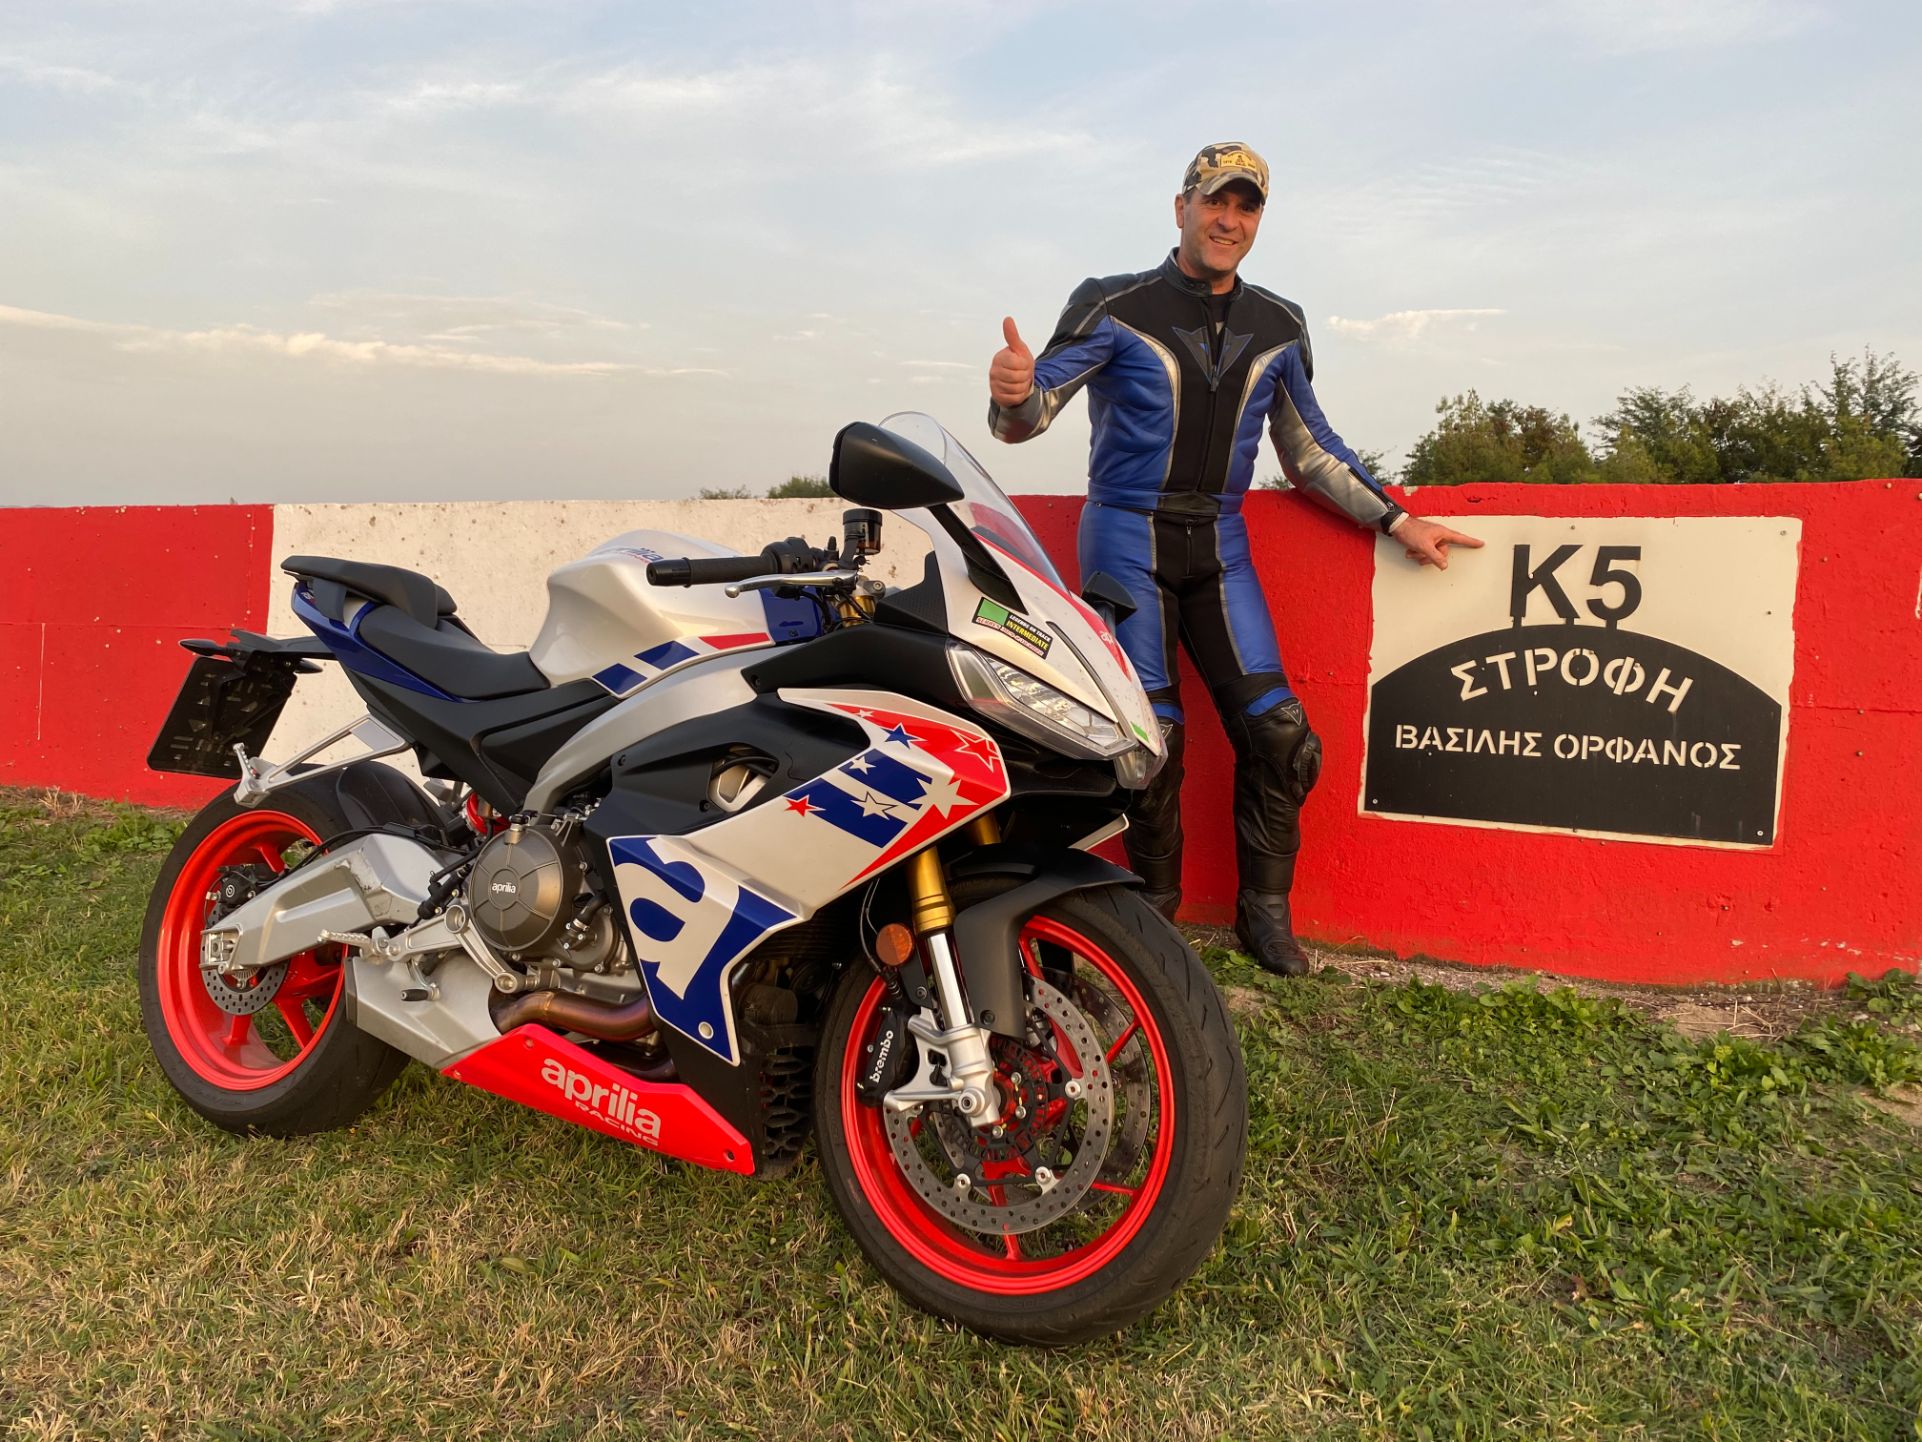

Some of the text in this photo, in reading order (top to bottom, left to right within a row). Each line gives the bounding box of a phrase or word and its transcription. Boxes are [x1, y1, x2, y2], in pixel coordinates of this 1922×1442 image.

[1006, 620, 1049, 650] INTERMEDIATE
[1450, 647, 1694, 714] ΣΤΡΟΦΗ
[1395, 723, 1742, 770] ΒΑΣΙΛΗΣ ΟΡΦΑΝΟΣ
[491, 881, 517, 894] aprilia
[869, 1030, 894, 1084] brembo
[541, 1058, 662, 1139] aprilia
[574, 1100, 659, 1146] RACING
